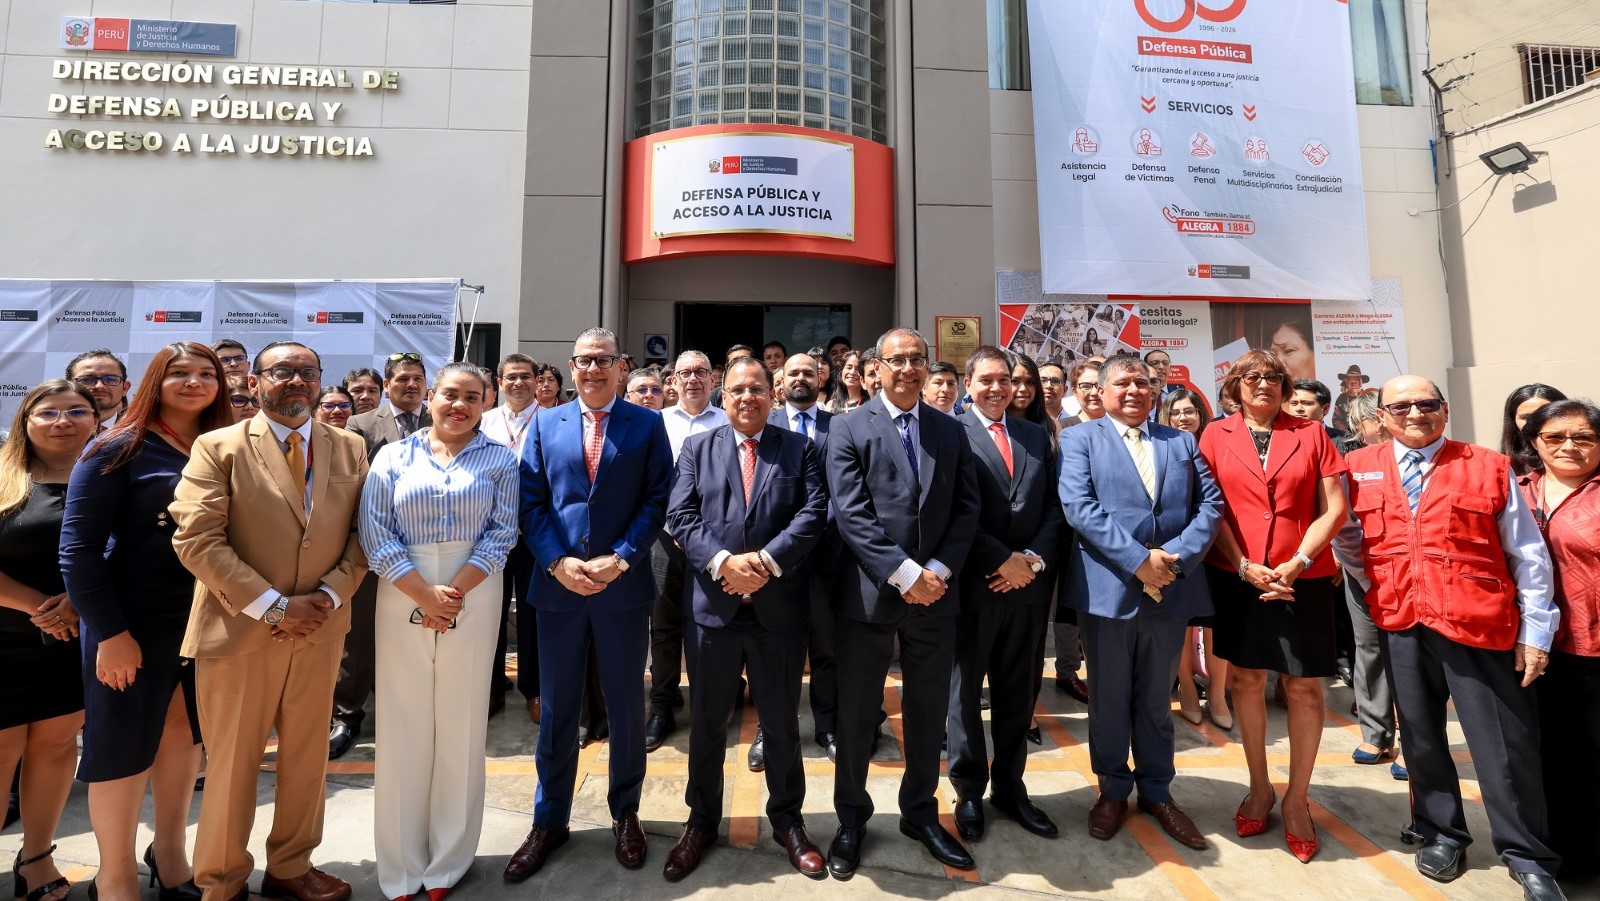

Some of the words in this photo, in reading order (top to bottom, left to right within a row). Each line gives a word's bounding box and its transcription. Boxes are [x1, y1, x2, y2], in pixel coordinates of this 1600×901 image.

[137, 24, 177, 32] Ministerio
[98, 28, 124, 39] PERÚ
[149, 33, 177, 41] Justicia
[143, 40, 180, 49] Derechos
[182, 43, 220, 51] Humanos
[1142, 40, 1196, 54] Defensa
[1200, 44, 1246, 59] Pública
[52, 60, 213, 84] DIRECCIÓN
[223, 66, 353, 88] GENERAL
[363, 70, 399, 90] DE
[1236, 73, 1259, 81] justicia
[48, 94, 181, 117] DEFENSA
[190, 94, 314, 121] PÚBLICA
[322, 102, 342, 121] Y
[1168, 101, 1233, 115] SERVICIOS
[44, 128, 164, 151] ACCESO
[172, 133, 192, 153] A
[200, 134, 236, 153] LA
[244, 134, 374, 156] JUSTICIA
[1061, 162, 1106, 170] Asistencia
[1132, 163, 1166, 172] Defensa
[1188, 166, 1220, 174] Defensa
[1072, 173, 1096, 182] Legal
[1243, 170, 1275, 179] Servicios
[1296, 174, 1342, 183] Conciliación
[1194, 176, 1216, 184] Penal
[1227, 178, 1293, 190] Multidisciplinarios
[682, 188, 743, 202] DEFENSA
[747, 184, 808, 201] PÚBLICA
[812, 191, 821, 202] Y
[1297, 184, 1342, 194] Extrajudicial
[673, 205, 730, 220] ACCESO
[733, 204, 743, 216] A
[747, 205, 764, 216] LA
[768, 205, 832, 221] JUSTICIA
[1182, 222, 1219, 231] ALEGRA
[1228, 223, 1249, 232] 1884
[1140, 306, 1182, 316] cesitas
[1172, 318, 1198, 328] legal?
